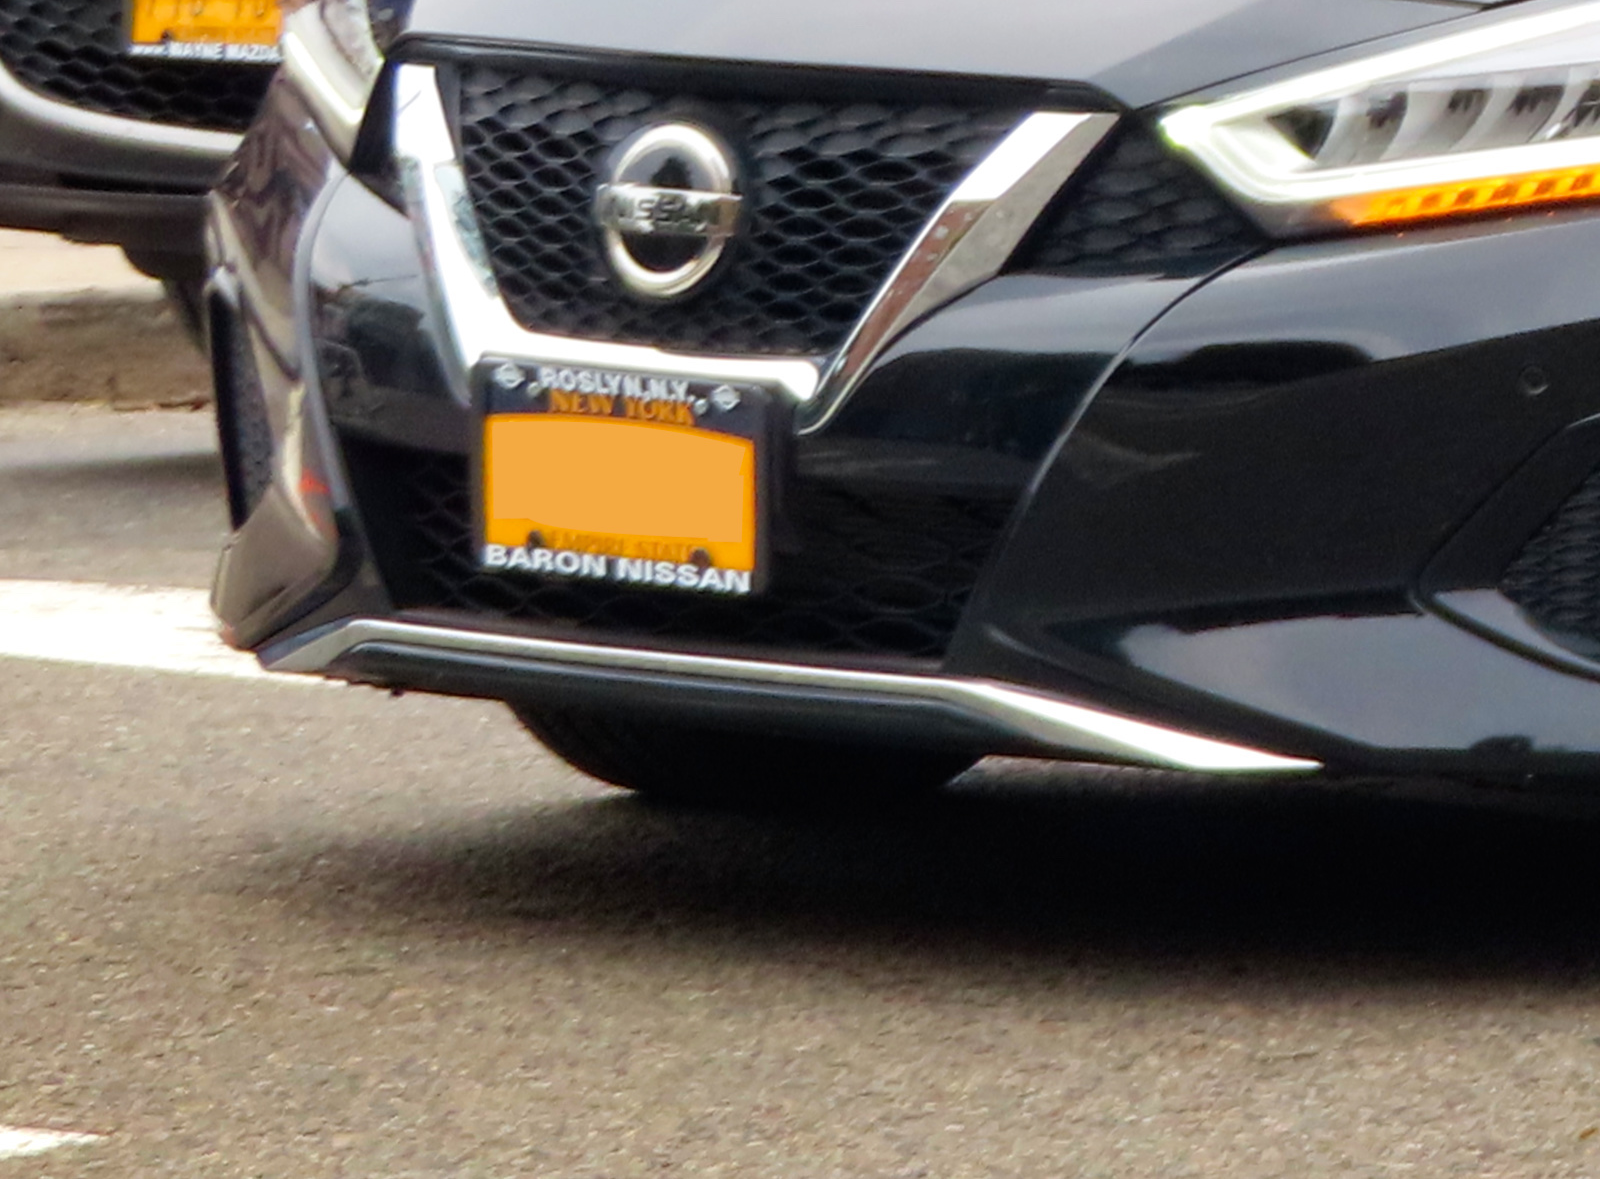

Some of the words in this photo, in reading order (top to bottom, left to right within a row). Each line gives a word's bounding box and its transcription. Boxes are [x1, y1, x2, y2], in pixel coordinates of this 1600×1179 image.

[550, 388, 613, 415] NEW
[484, 542, 607, 577] BARON
[614, 558, 751, 593] NISSAN
